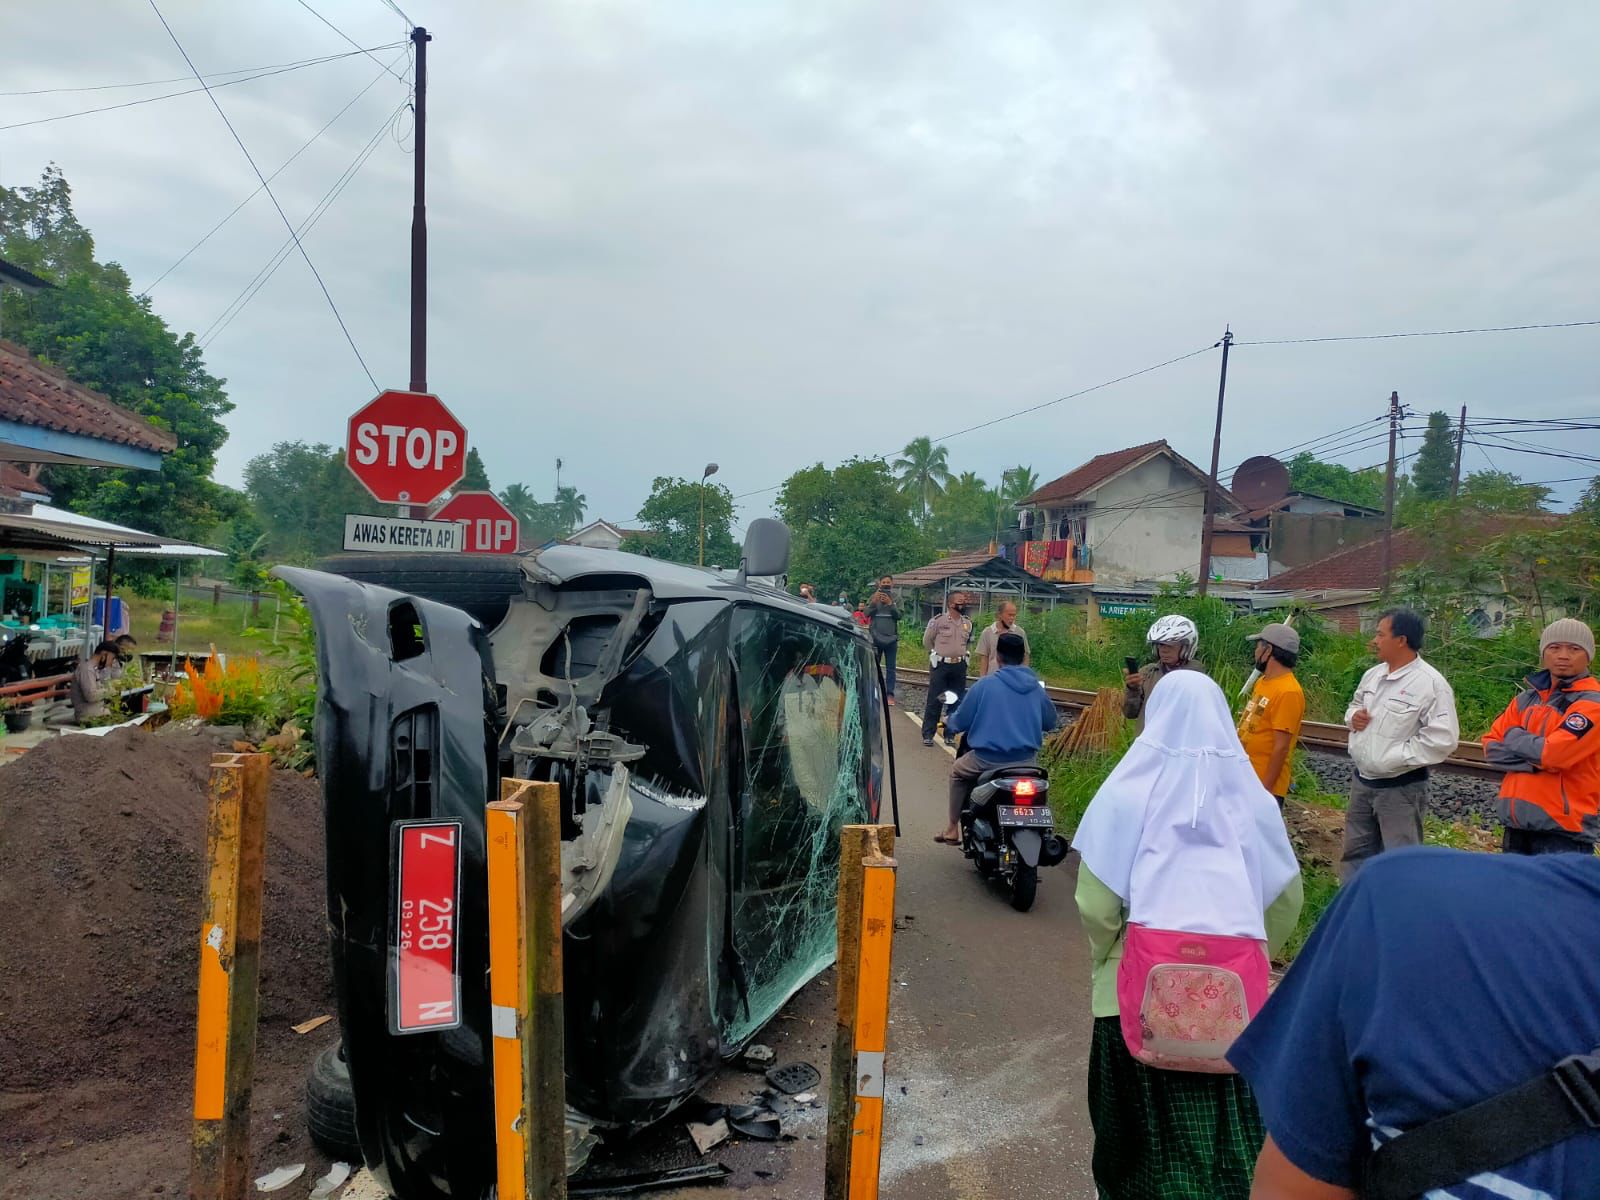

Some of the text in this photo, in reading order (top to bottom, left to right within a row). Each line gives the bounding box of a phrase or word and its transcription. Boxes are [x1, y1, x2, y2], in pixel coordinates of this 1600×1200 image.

[355, 422, 458, 471] STOP
[353, 523, 455, 549] AWAS KERETA API
[456, 518, 512, 550] TOP
[418, 830, 455, 1021] Z 258 N
